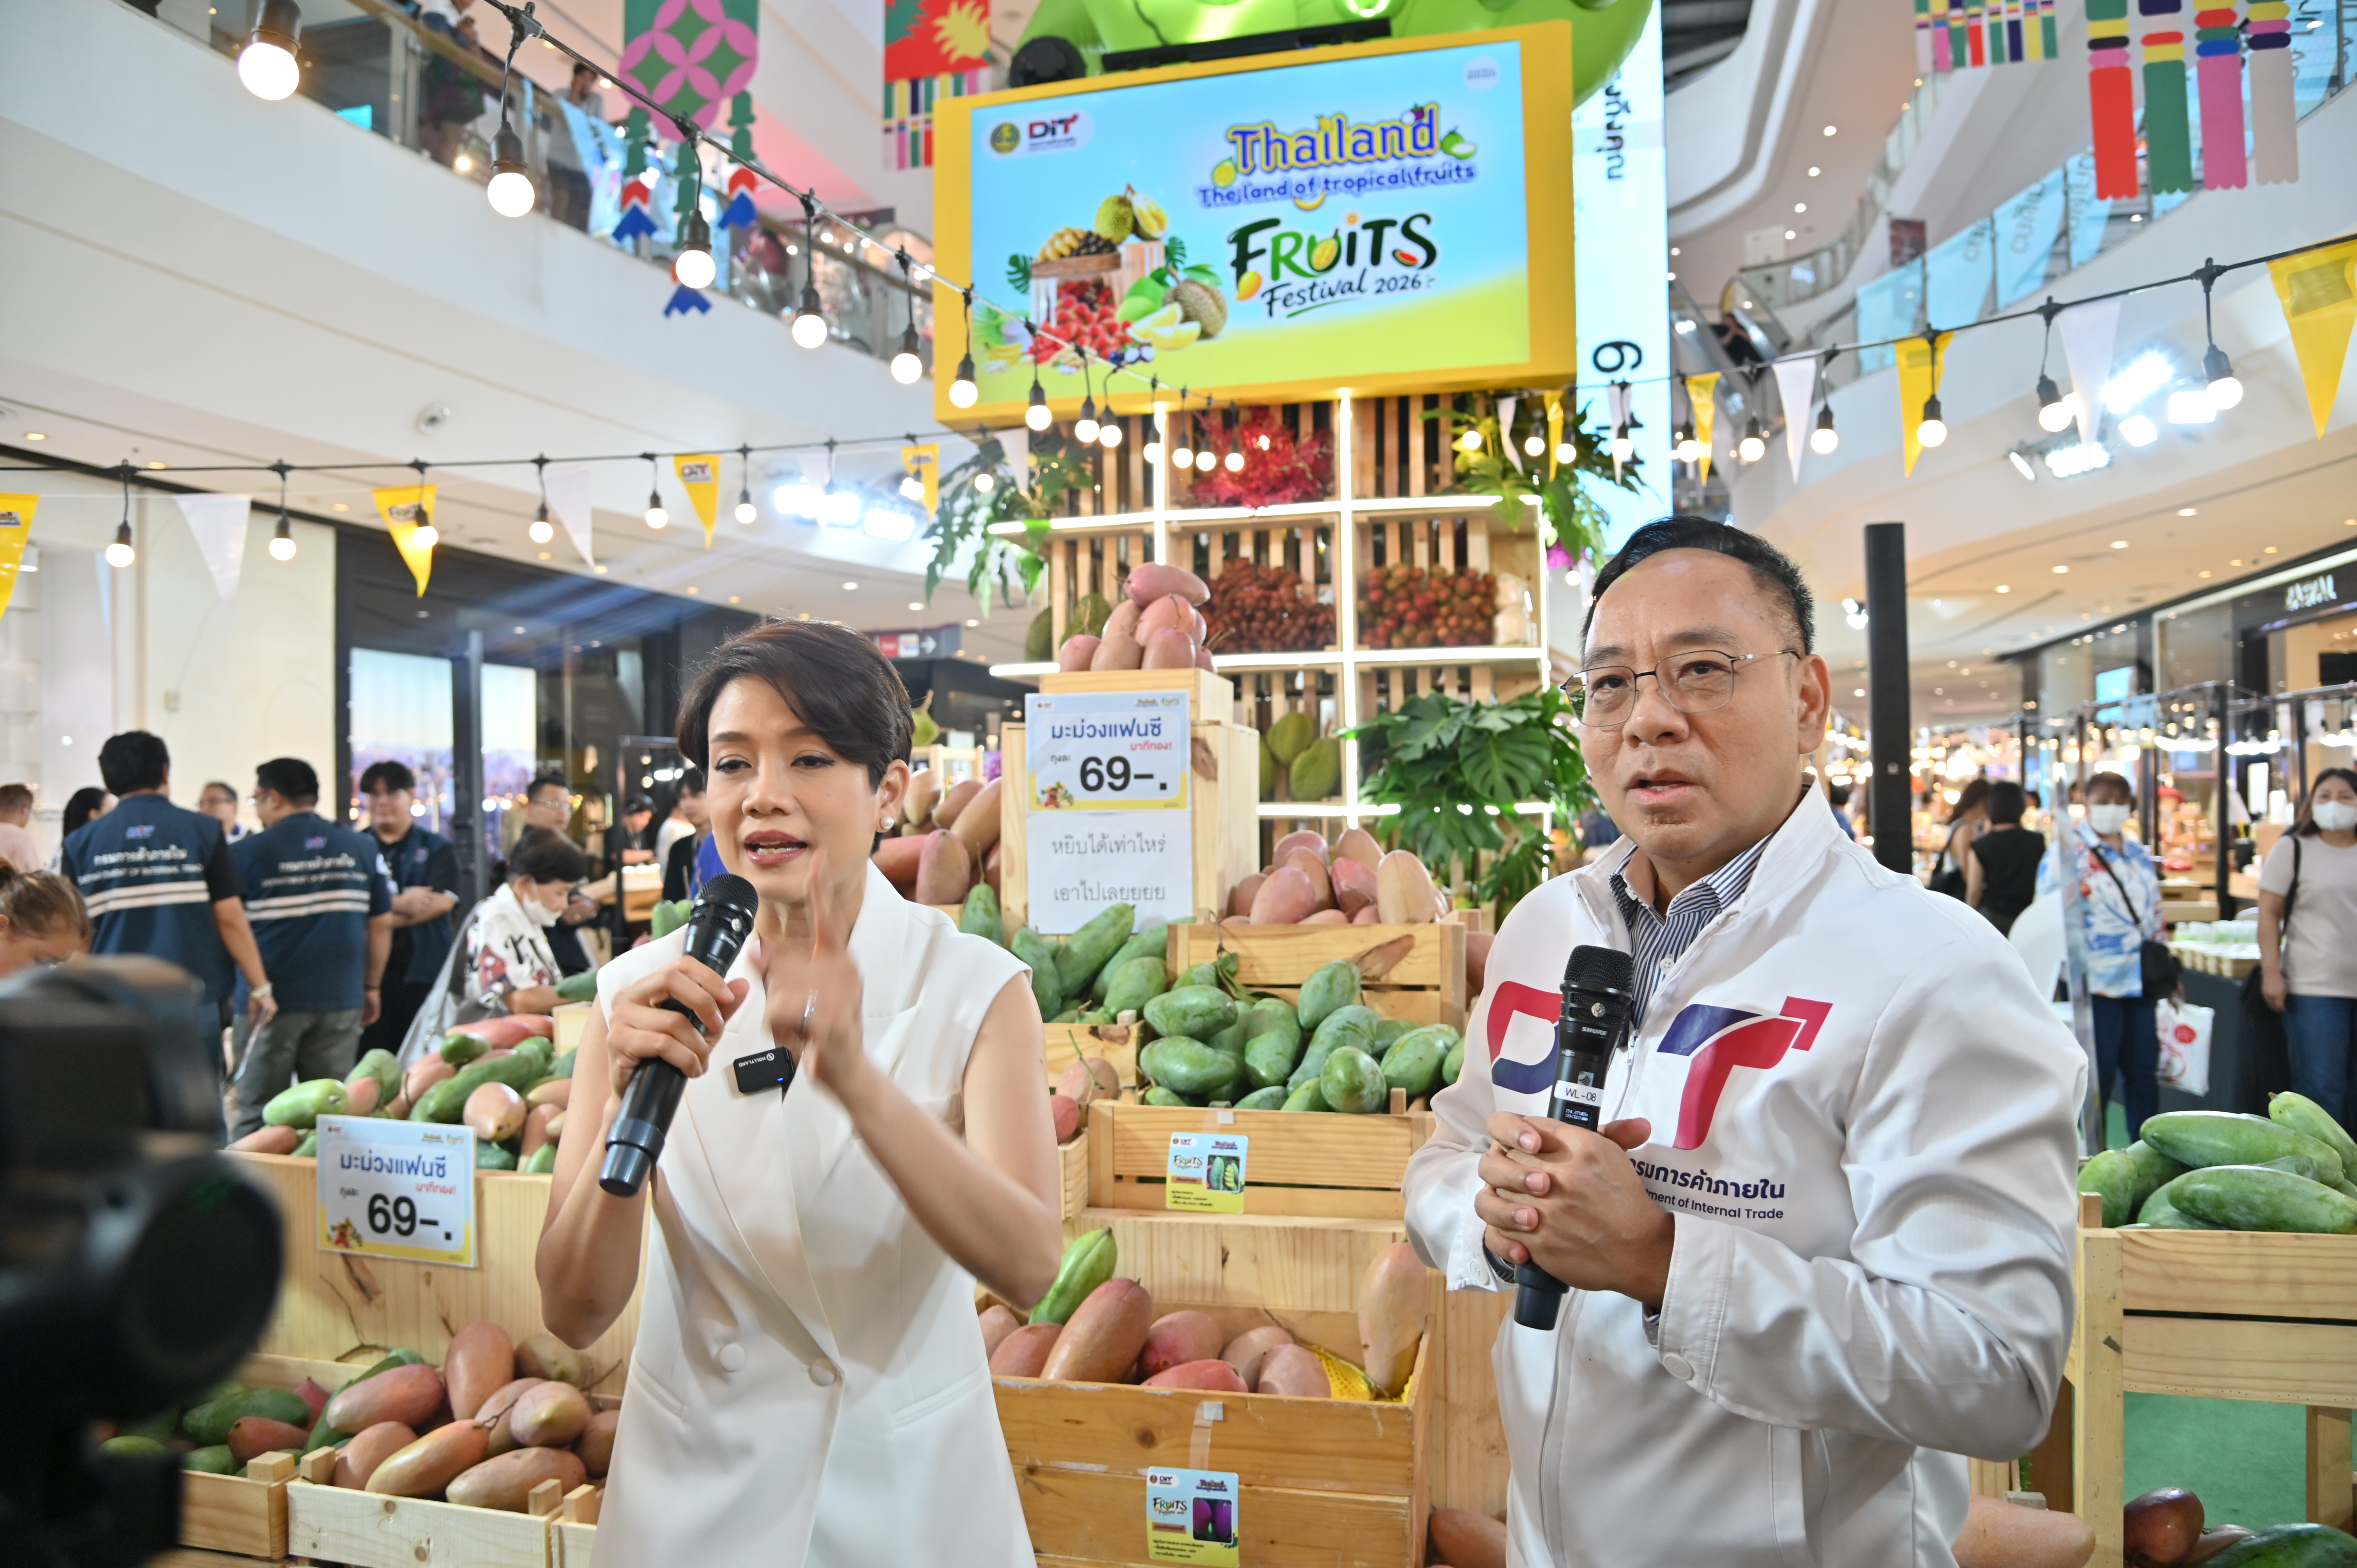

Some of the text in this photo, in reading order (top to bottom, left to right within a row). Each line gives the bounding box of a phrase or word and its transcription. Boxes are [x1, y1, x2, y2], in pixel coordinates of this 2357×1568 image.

[1597, 71, 1631, 179] งถึงคุณ
[1228, 104, 1439, 172] Thailand
[1199, 166, 1475, 203] The land of tropical fruits
[1262, 268, 1422, 317] Festival 2026
[1052, 717, 1162, 739] มะม่วงแฟนซี
[1052, 832, 1166, 854] หยิบได้เท่าไหร่
[1055, 879, 1166, 901] เอาไปเลยยยย
[1581, 1026, 1608, 1036] SHURE
[738, 1056, 767, 1068] HOLLYLAND
[340, 1149, 447, 1178] มะม่วงแฟนซี
[1678, 1197, 1689, 1208] of
[1691, 1200, 1741, 1218] Internal
[1745, 1208, 1784, 1219] Trade
